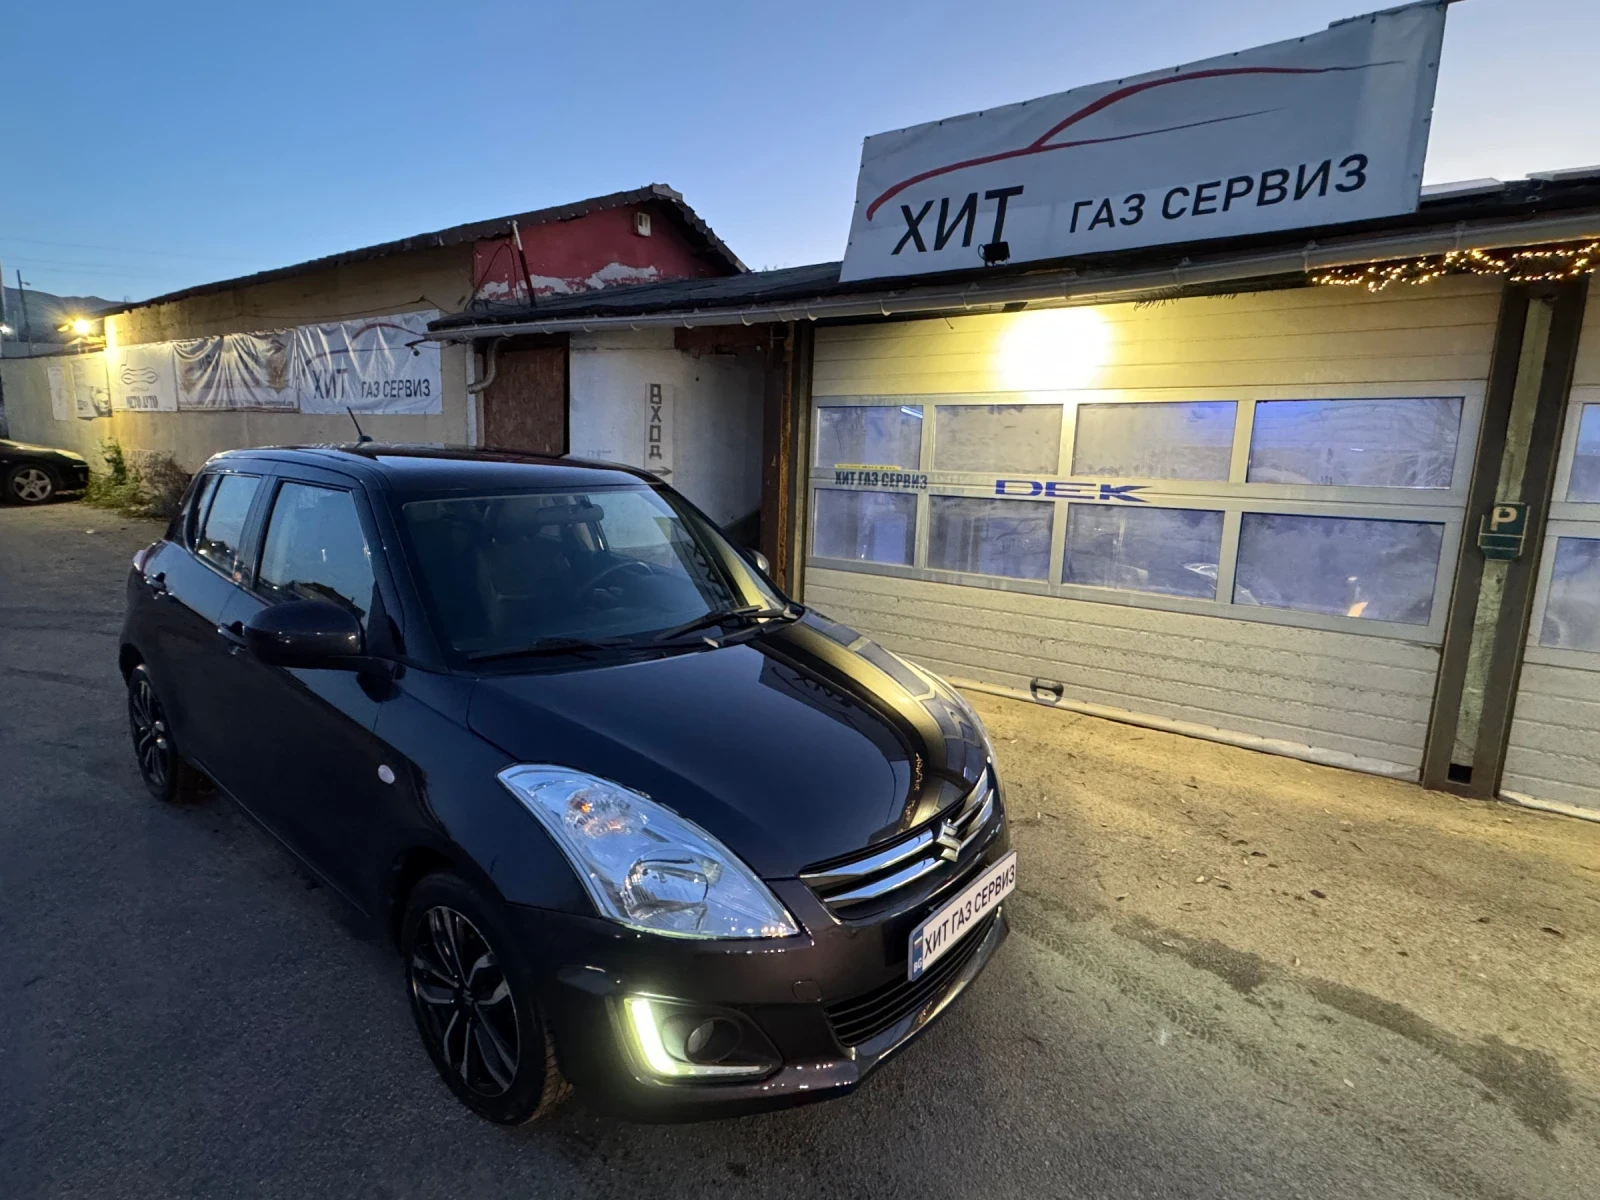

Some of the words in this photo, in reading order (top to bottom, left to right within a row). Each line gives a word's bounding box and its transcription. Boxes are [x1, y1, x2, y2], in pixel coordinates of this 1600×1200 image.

[890, 185, 1024, 255] ХИТ
[1069, 193, 1146, 233] ГАЗ
[1161, 153, 1368, 220] СЕРВИЗ
[313, 367, 348, 399] ХИТ
[361, 381, 380, 398] ГАЗ
[383, 378, 431, 398] СЕРВИЗ
[648, 383, 662, 460] ВХОД
[835, 471, 856, 486] ХИТ
[858, 471, 879, 487] ГАЗ
[881, 472, 928, 489] СЕРВИЗ
[995, 479, 1153, 503] DEK
[1490, 506, 1517, 532] P
[924, 918, 949, 959] ХИТ
[951, 901, 972, 934] ГАЗ
[974, 864, 1015, 913] СЕРВИЗ
[913, 958, 923, 973] BG
